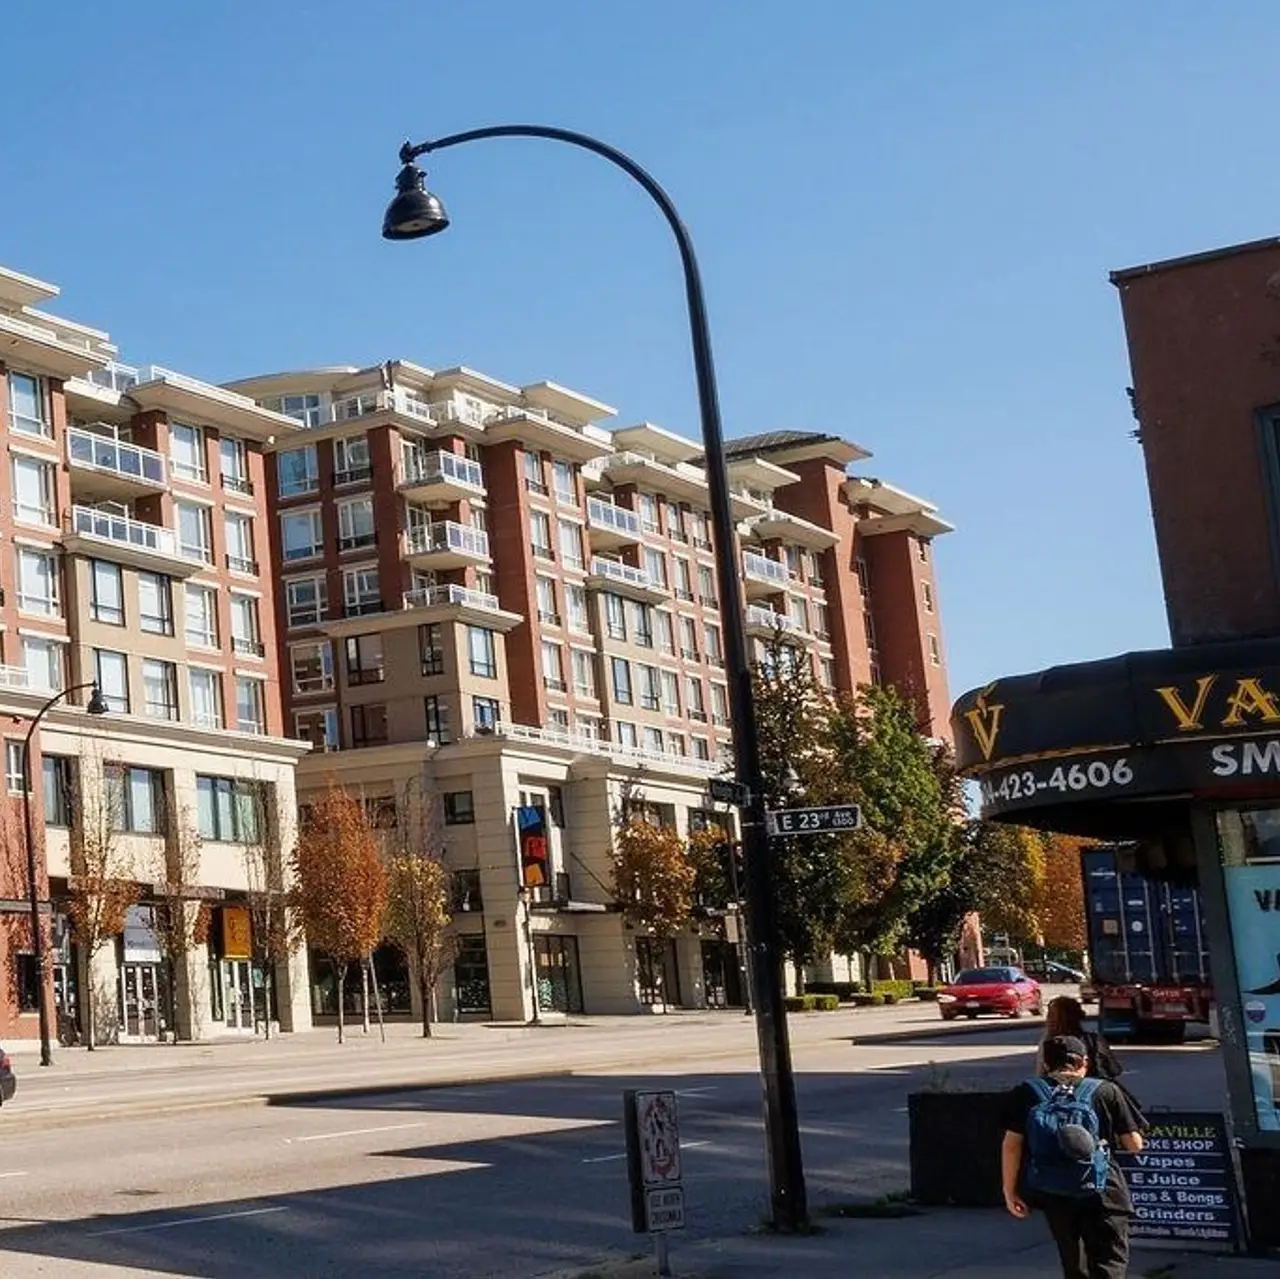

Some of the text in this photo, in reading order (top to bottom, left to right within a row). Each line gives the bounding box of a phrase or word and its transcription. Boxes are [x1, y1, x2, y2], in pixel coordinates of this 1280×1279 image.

[1212, 740, 1280, 776] SM
[782, 815, 793, 830] E
[834, 810, 851, 819] Ave
[1172, 1140, 1214, 1150] SHOP
[1135, 1155, 1196, 1169] Vapes
[1131, 1173, 1201, 1186] E Juice
[1160, 1190, 1171, 1202] &
[1176, 1191, 1224, 1205] Bongs
[1135, 1206, 1215, 1221] Grinders
